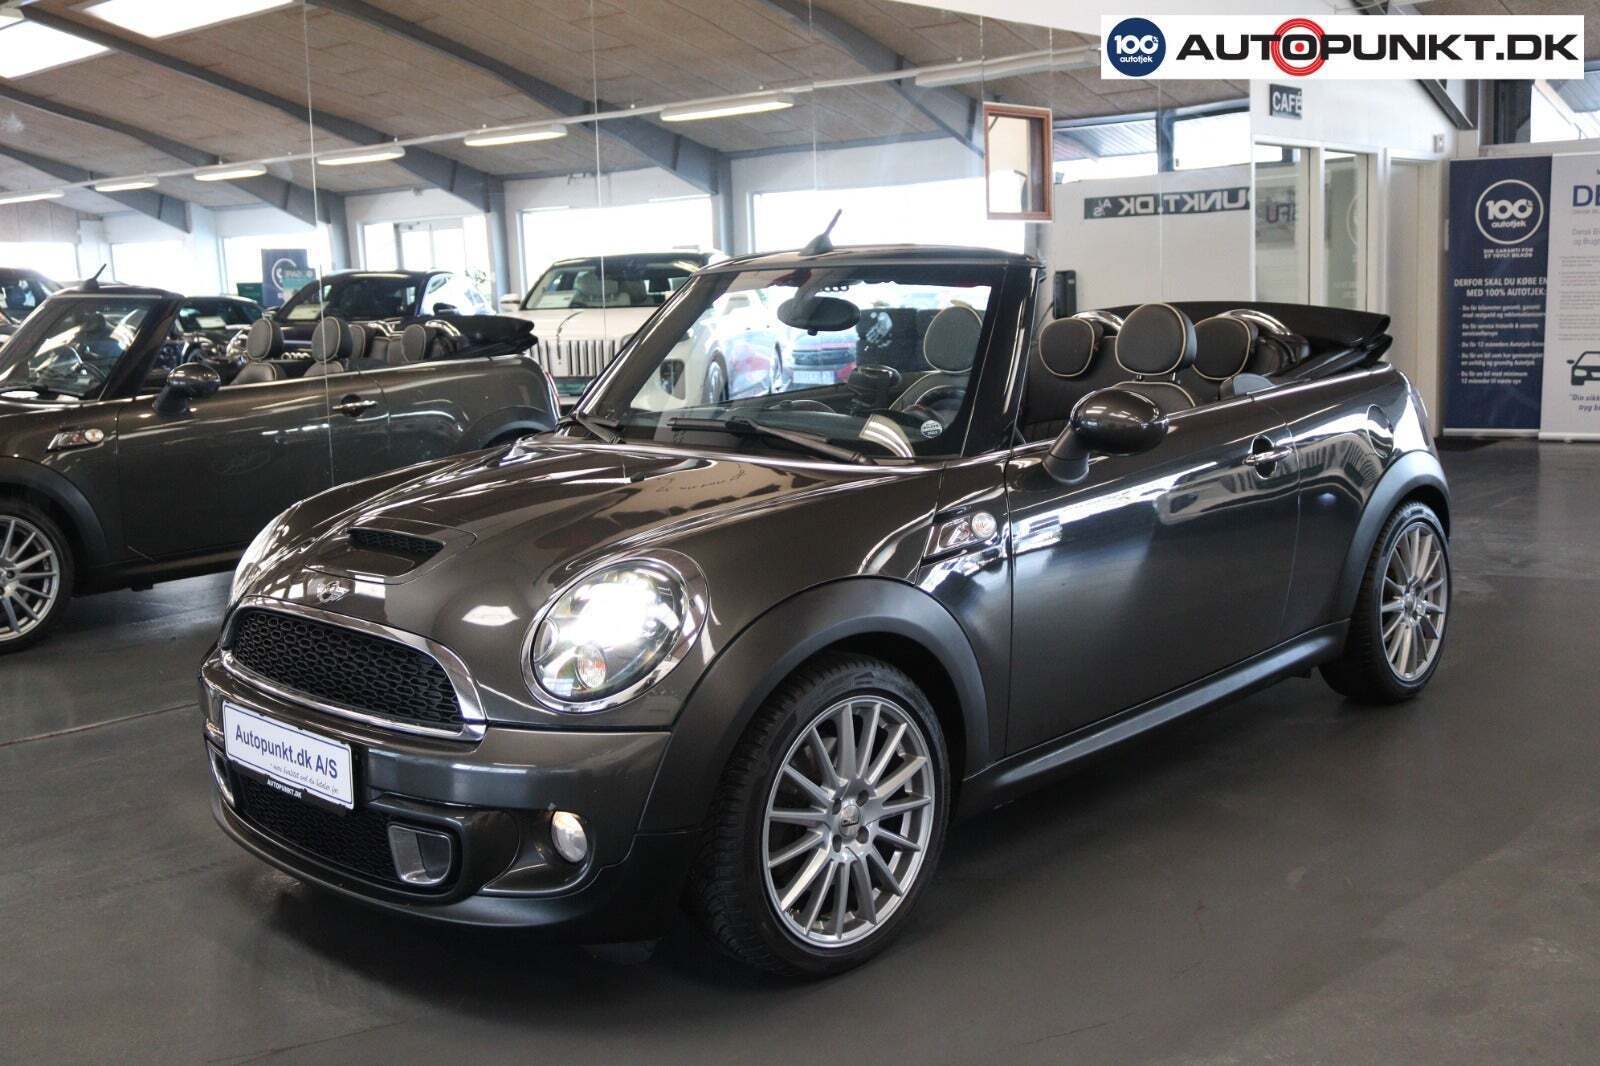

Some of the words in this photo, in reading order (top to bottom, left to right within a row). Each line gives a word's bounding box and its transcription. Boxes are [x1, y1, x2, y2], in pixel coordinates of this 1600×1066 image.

[1454, 278, 1483, 287] DERFOR
[1484, 278, 1502, 286] SKAL
[1504, 278, 1515, 286] DU
[1466, 289, 1484, 297] MED
[1486, 288, 1506, 297] 100%
[235, 723, 312, 770] Autopunkt.dk
[315, 754, 338, 779] A/S
